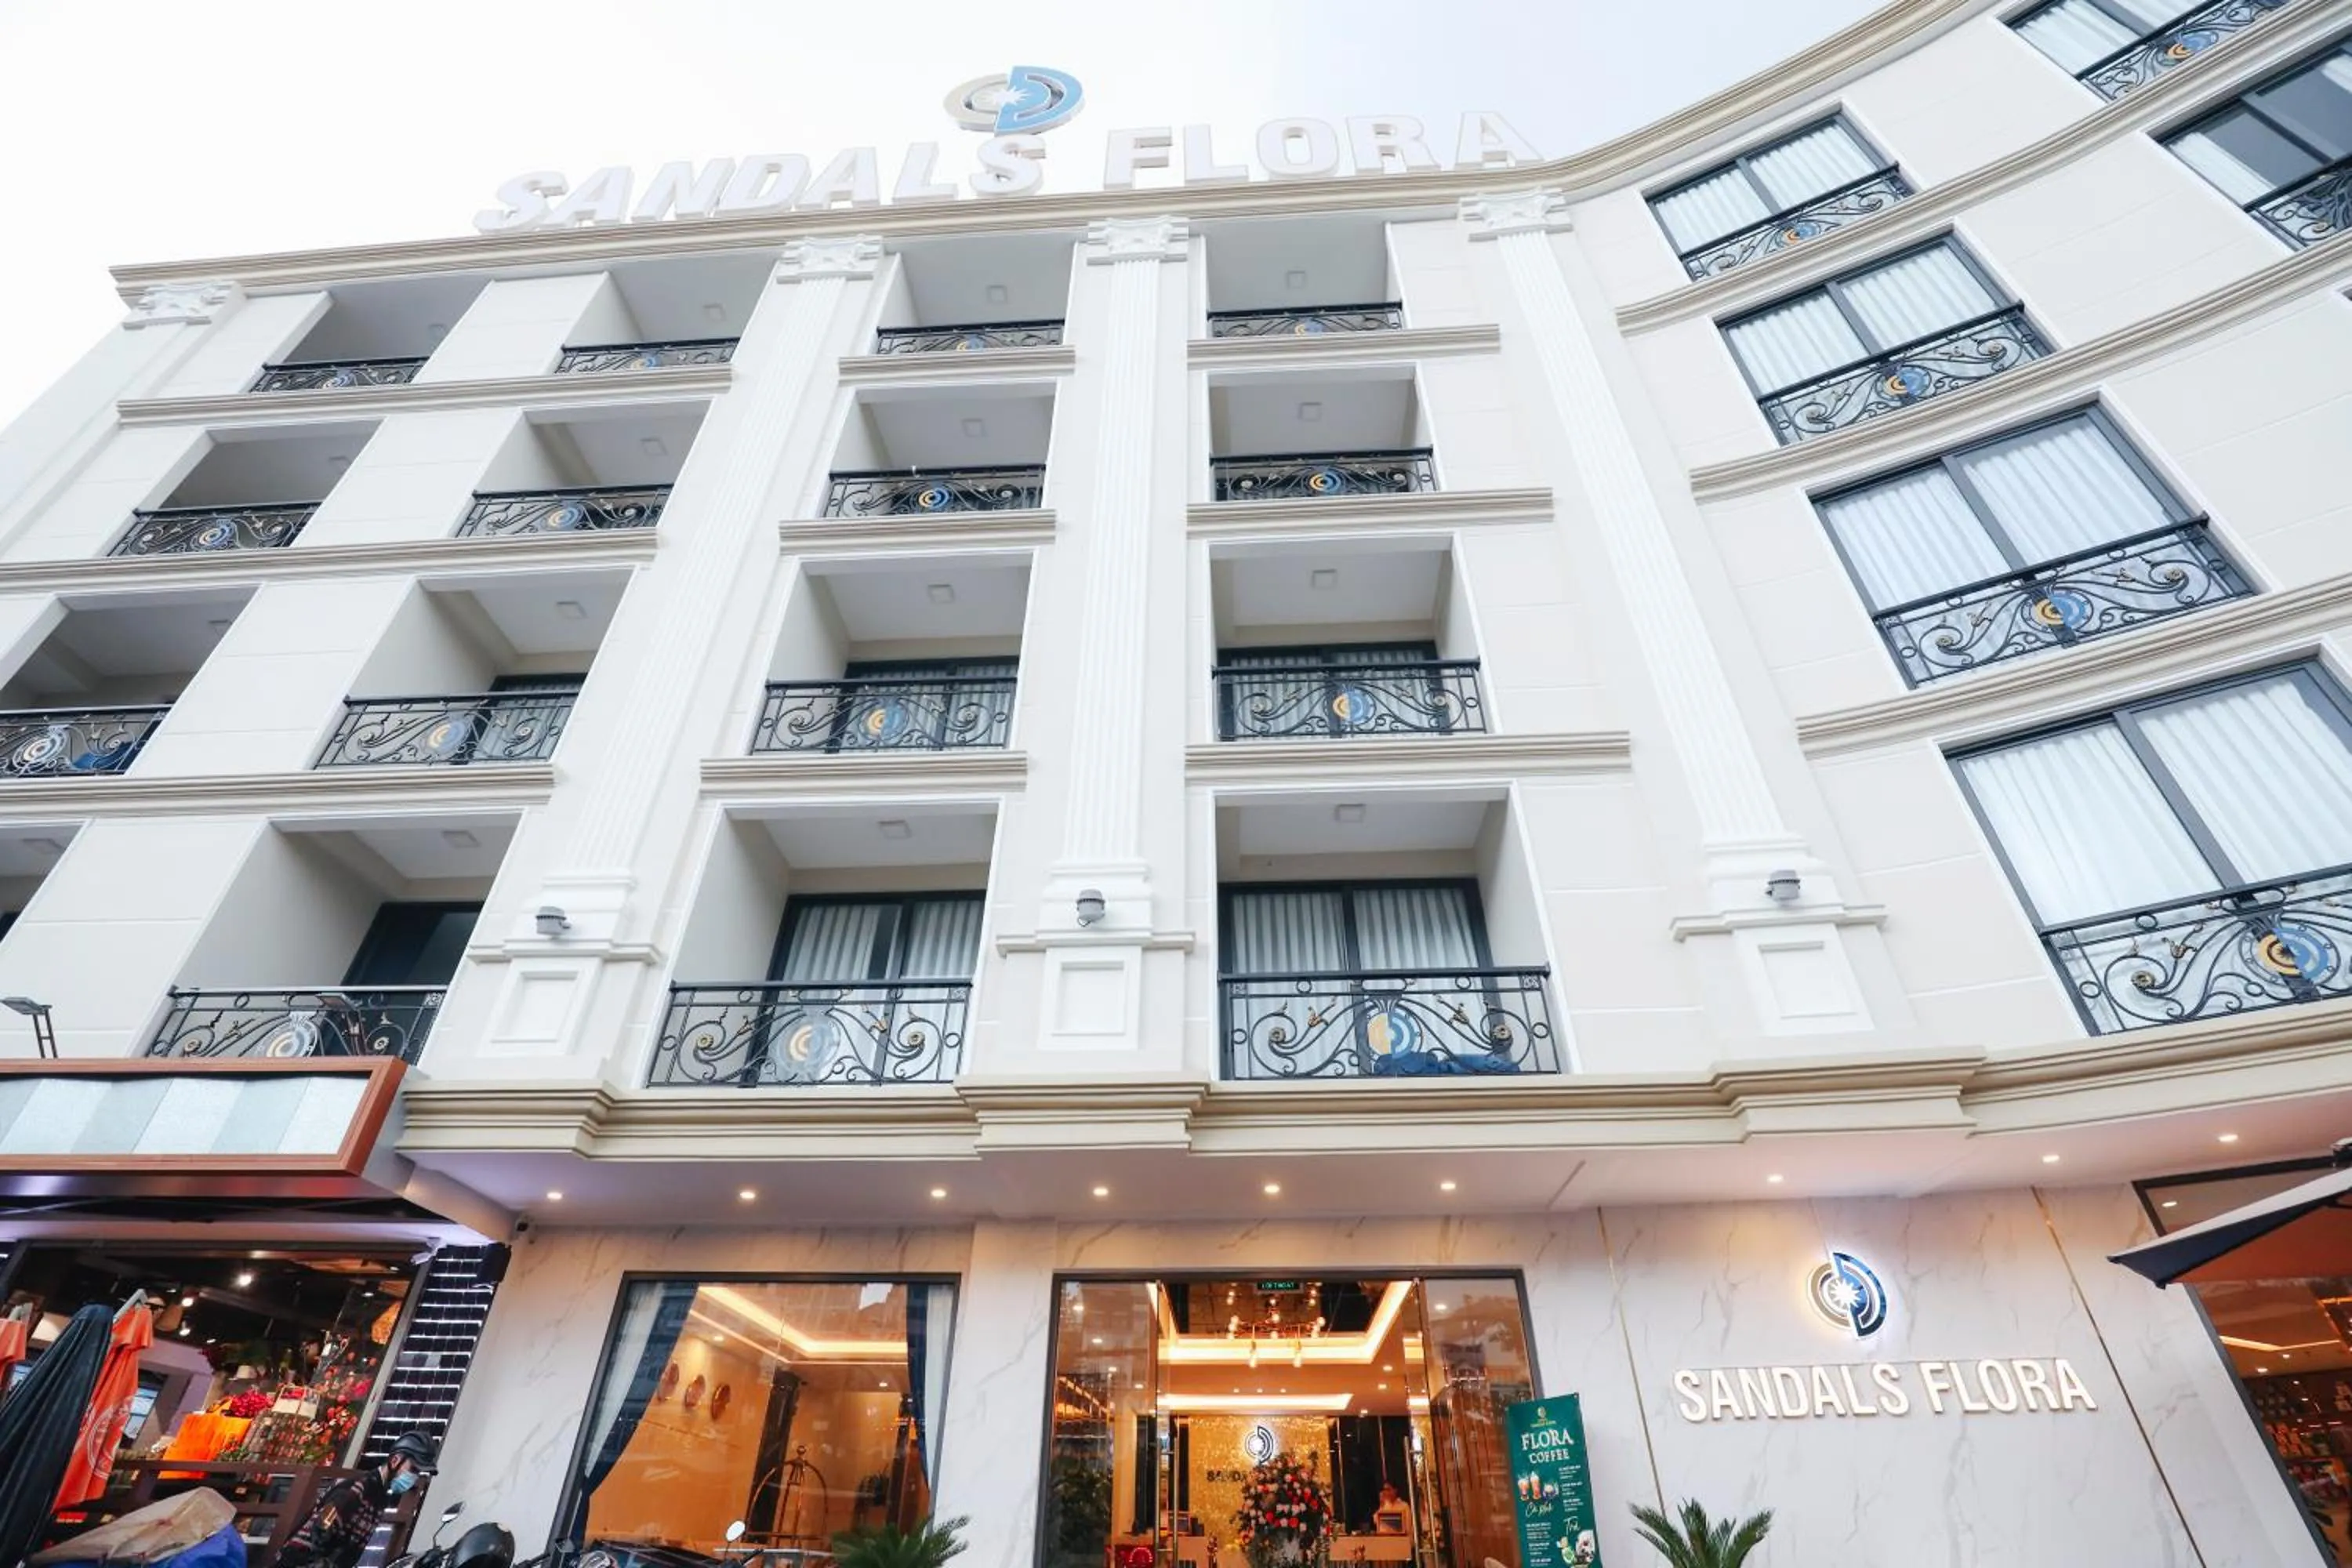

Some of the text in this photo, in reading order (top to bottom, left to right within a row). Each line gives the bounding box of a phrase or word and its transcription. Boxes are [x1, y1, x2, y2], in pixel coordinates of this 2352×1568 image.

[474, 111, 1547, 234] SANDALS FLORA
[1674, 1358, 2098, 1422] SANDALS FLORA
[1521, 1428, 1574, 1450] FLORA
[1529, 1448, 1570, 1464] COFFEE
